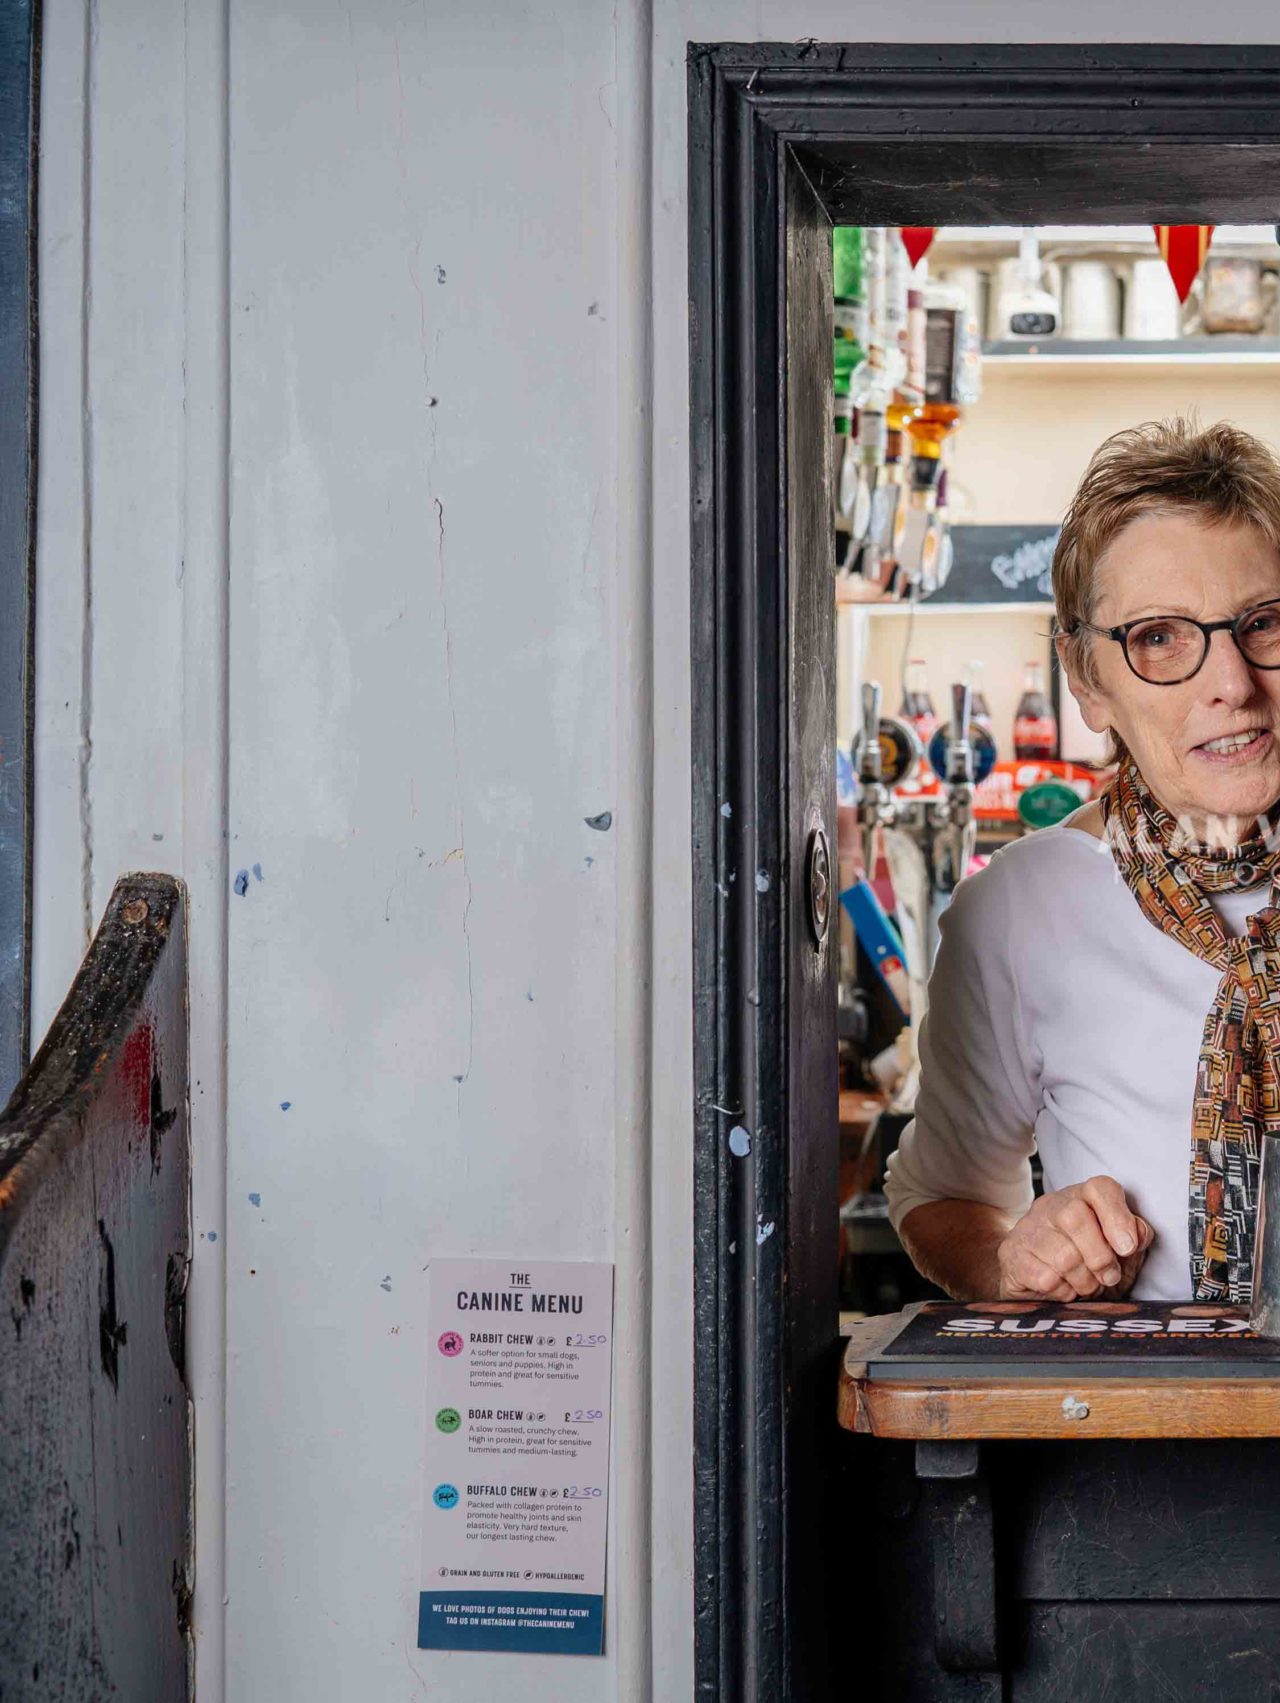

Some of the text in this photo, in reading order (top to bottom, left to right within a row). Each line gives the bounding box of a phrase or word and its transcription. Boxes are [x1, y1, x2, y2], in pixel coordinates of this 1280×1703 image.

[510, 1273, 531, 1285] THE
[457, 1291, 583, 1314] CANINE MENU
[470, 1333, 503, 1343] RABBIT
[506, 1334, 533, 1345] CHEW
[548, 1362, 565, 1371] High
[470, 1370, 497, 1379] protein
[514, 1372, 533, 1380] great
[546, 1372, 580, 1381] sensitive
[468, 1409, 493, 1420] BOAR
[497, 1410, 523, 1421] CHEW
[526, 1428, 556, 1437] crunchy
[468, 1436, 486, 1444] High
[526, 1438, 546, 1446] great
[559, 1439, 592, 1447] sensitive
[467, 1485, 507, 1496] BUFFALO
[510, 1486, 537, 1497] CHEW
[467, 1501, 494, 1509] Packed
[496, 1501, 512, 1509] with
[513, 1502, 545, 1511] collagen
[546, 1503, 573, 1512] protein
[467, 1512, 498, 1520] promote
[500, 1512, 527, 1521] healthy
[529, 1513, 549, 1521] joints
[503, 1523, 520, 1531] Very
[480, 1533, 508, 1542] longest
[509, 1534, 534, 1543] lasting
[432, 1604, 442, 1612] WE
[444, 1604, 459, 1613] LOVE
[461, 1605, 485, 1613] PHOTOS
[487, 1606, 496, 1614] OF
[497, 1606, 514, 1615] DOGS
[516, 1607, 547, 1616] ENJOYING
[549, 1608, 567, 1616] THEIR
